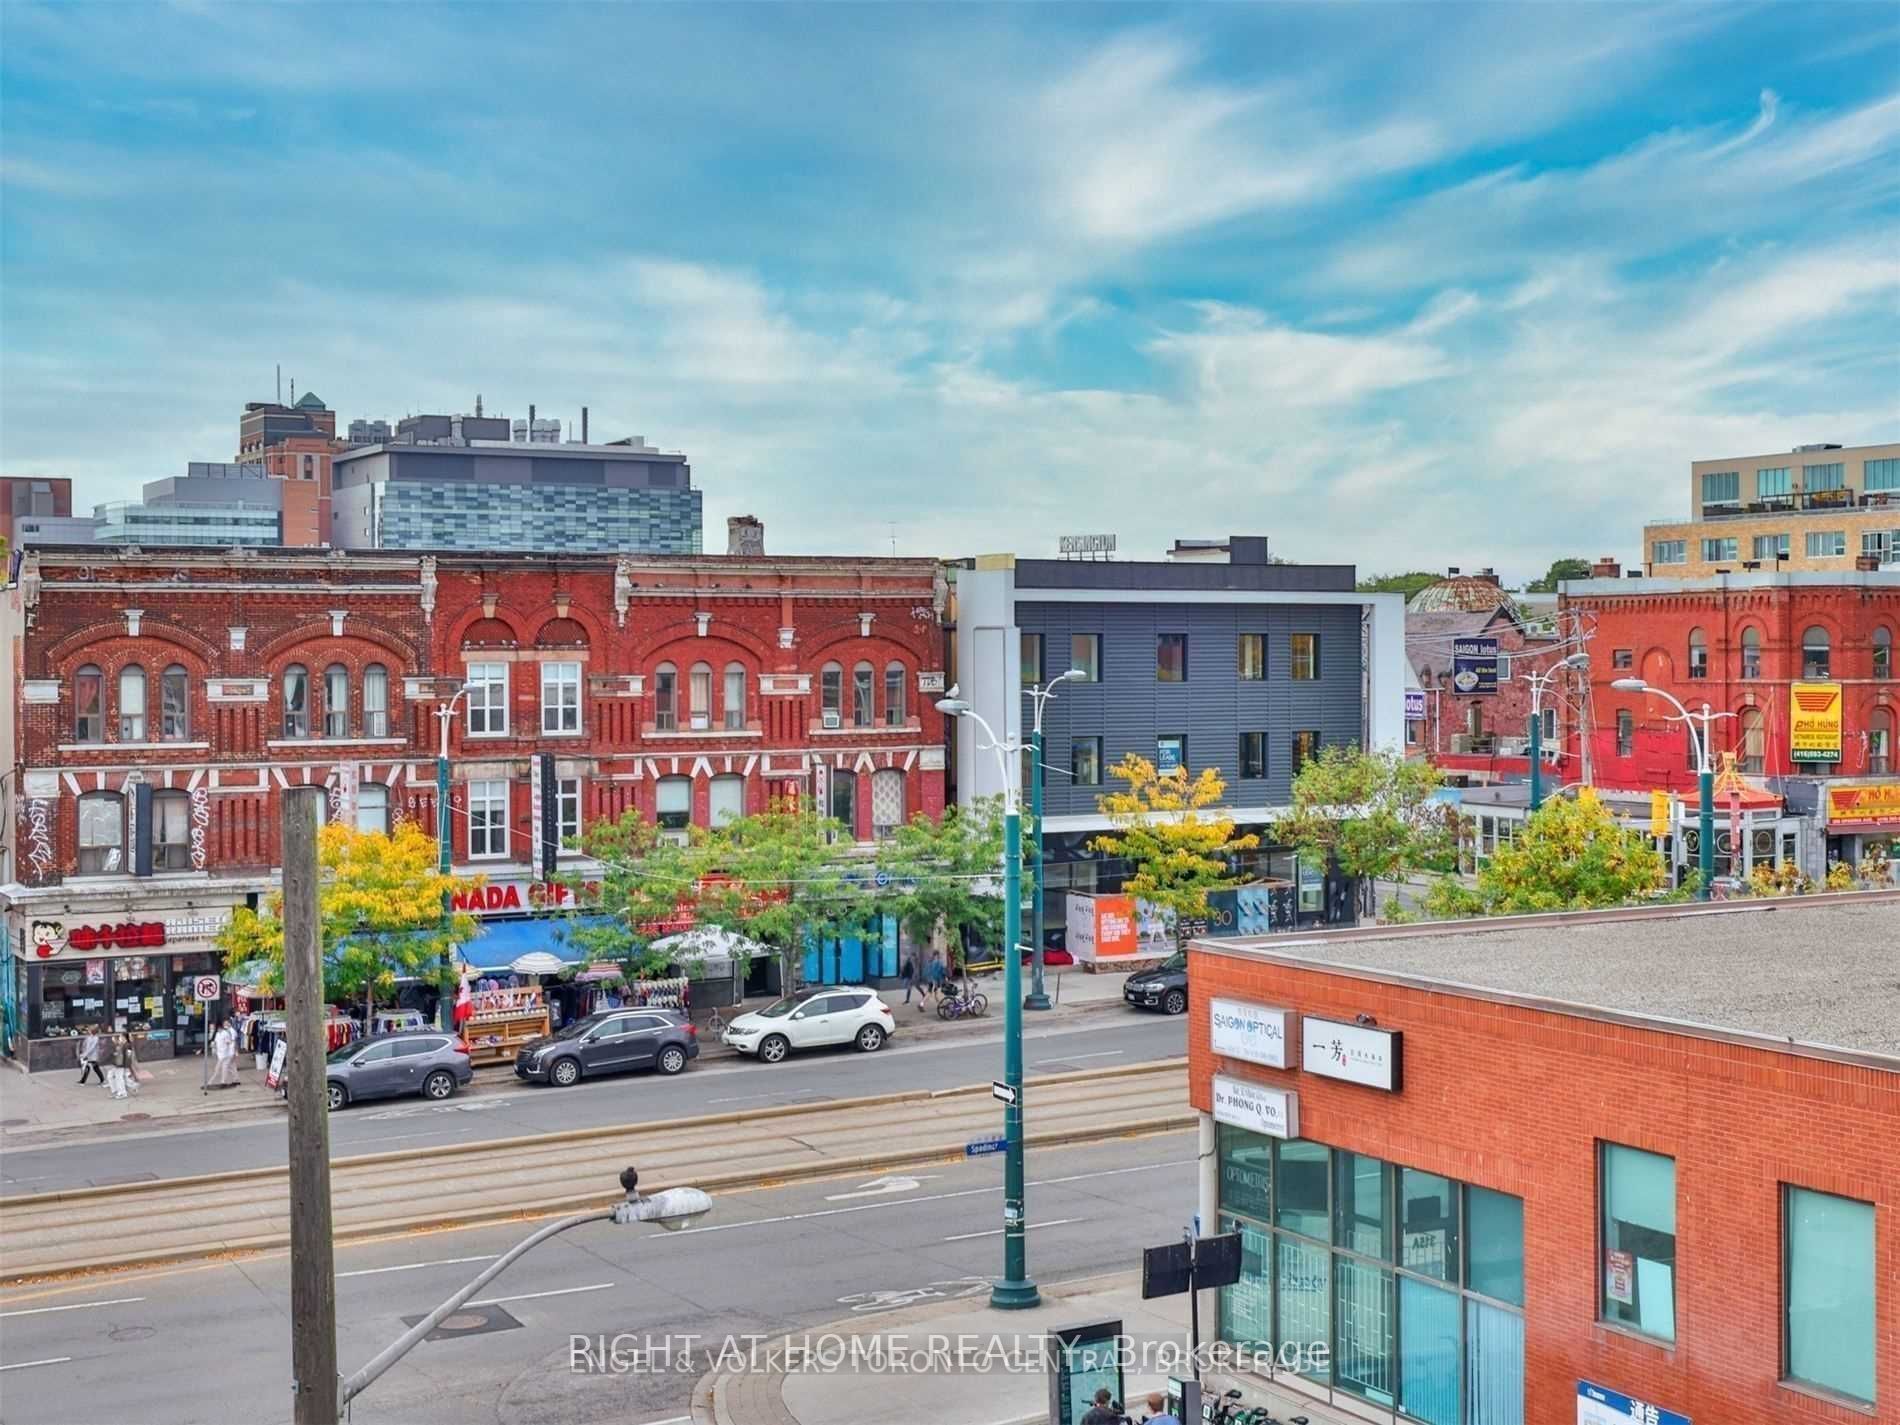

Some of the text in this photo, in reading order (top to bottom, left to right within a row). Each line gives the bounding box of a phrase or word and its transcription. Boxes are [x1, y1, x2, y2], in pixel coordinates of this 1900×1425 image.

[1406, 695, 1424, 712] otus
[1214, 1012, 1246, 1031] SAIGON
[1246, 1019, 1283, 1040] OPTICAL
